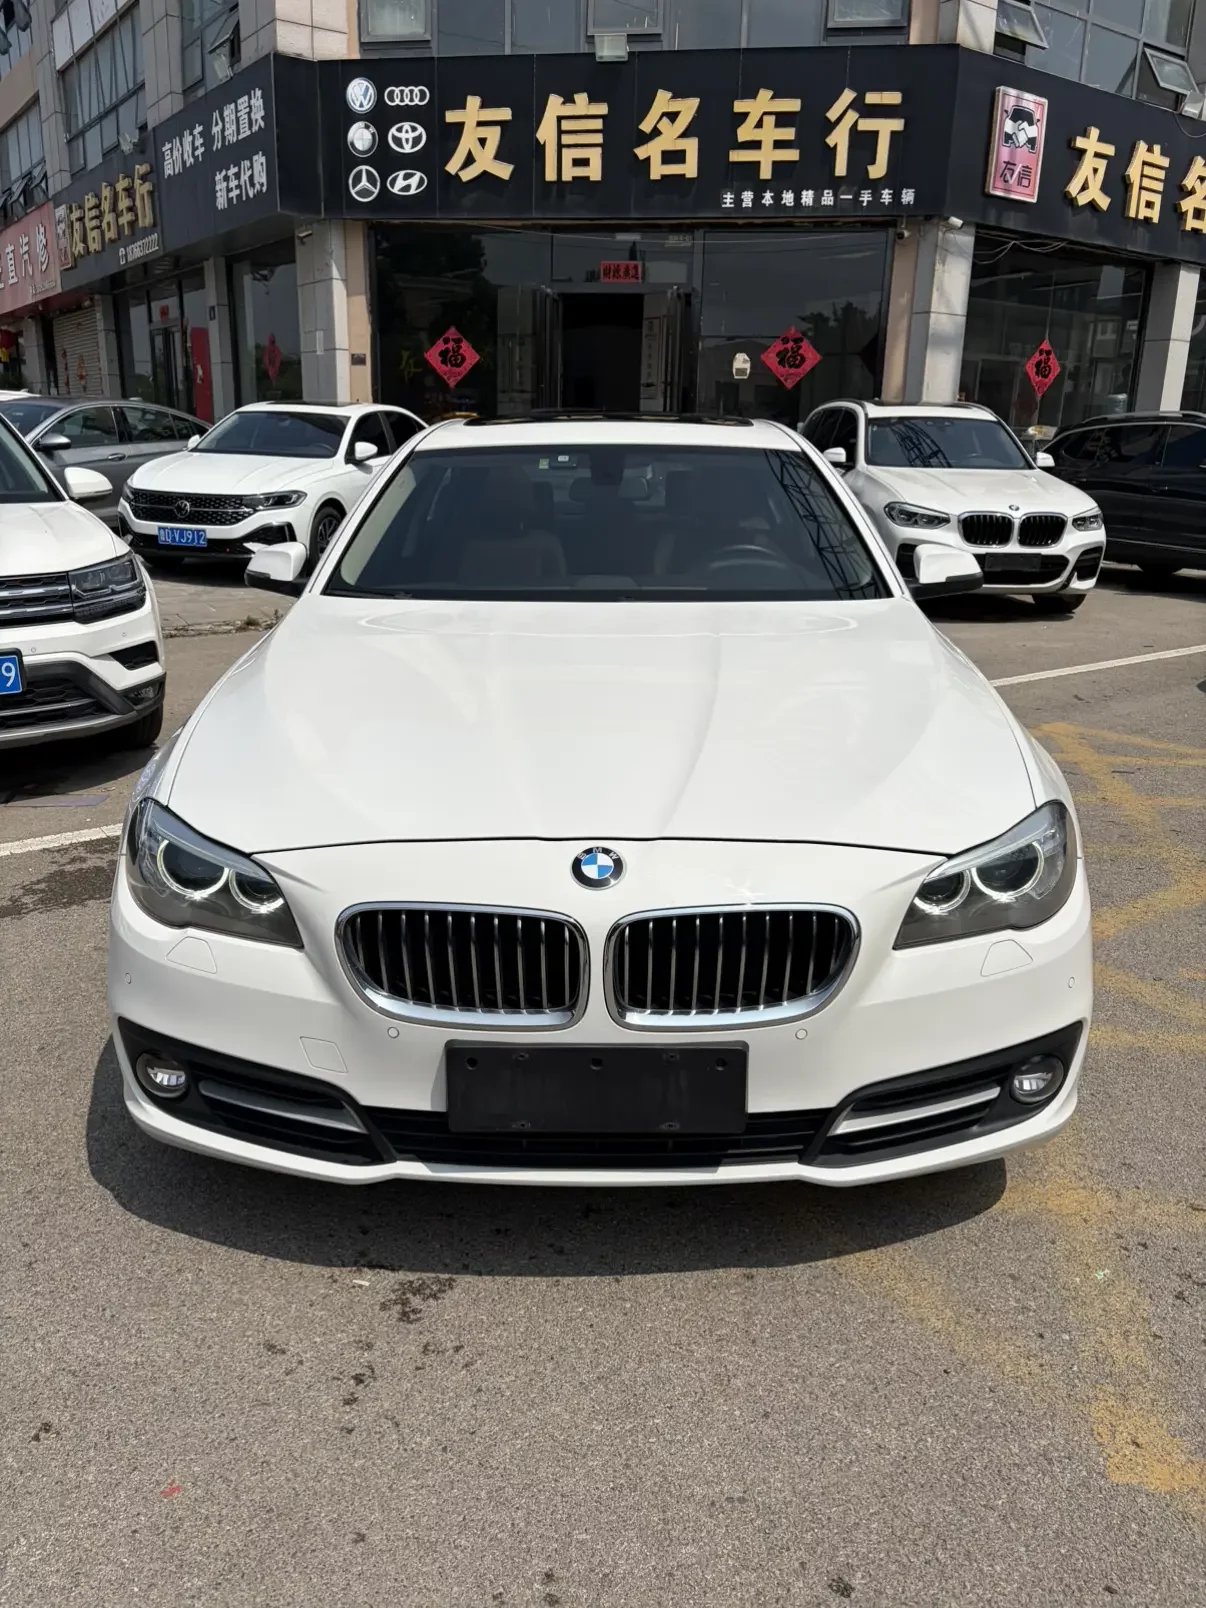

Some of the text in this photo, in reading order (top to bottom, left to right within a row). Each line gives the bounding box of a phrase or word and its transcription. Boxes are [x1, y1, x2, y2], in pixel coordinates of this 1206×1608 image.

[162, 87, 265, 178] 高价收车 分期置换
[445, 88, 905, 182] 友信名车行
[215, 151, 268, 210] 新车代购
[1000, 159, 1033, 188] 友信
[70, 163, 153, 258] 友信名车行
[0, 223, 50, 289] 直汽修
[439, 336, 467, 368] 福
[775, 336, 806, 369] 福
[1035, 348, 1052, 379] 福
